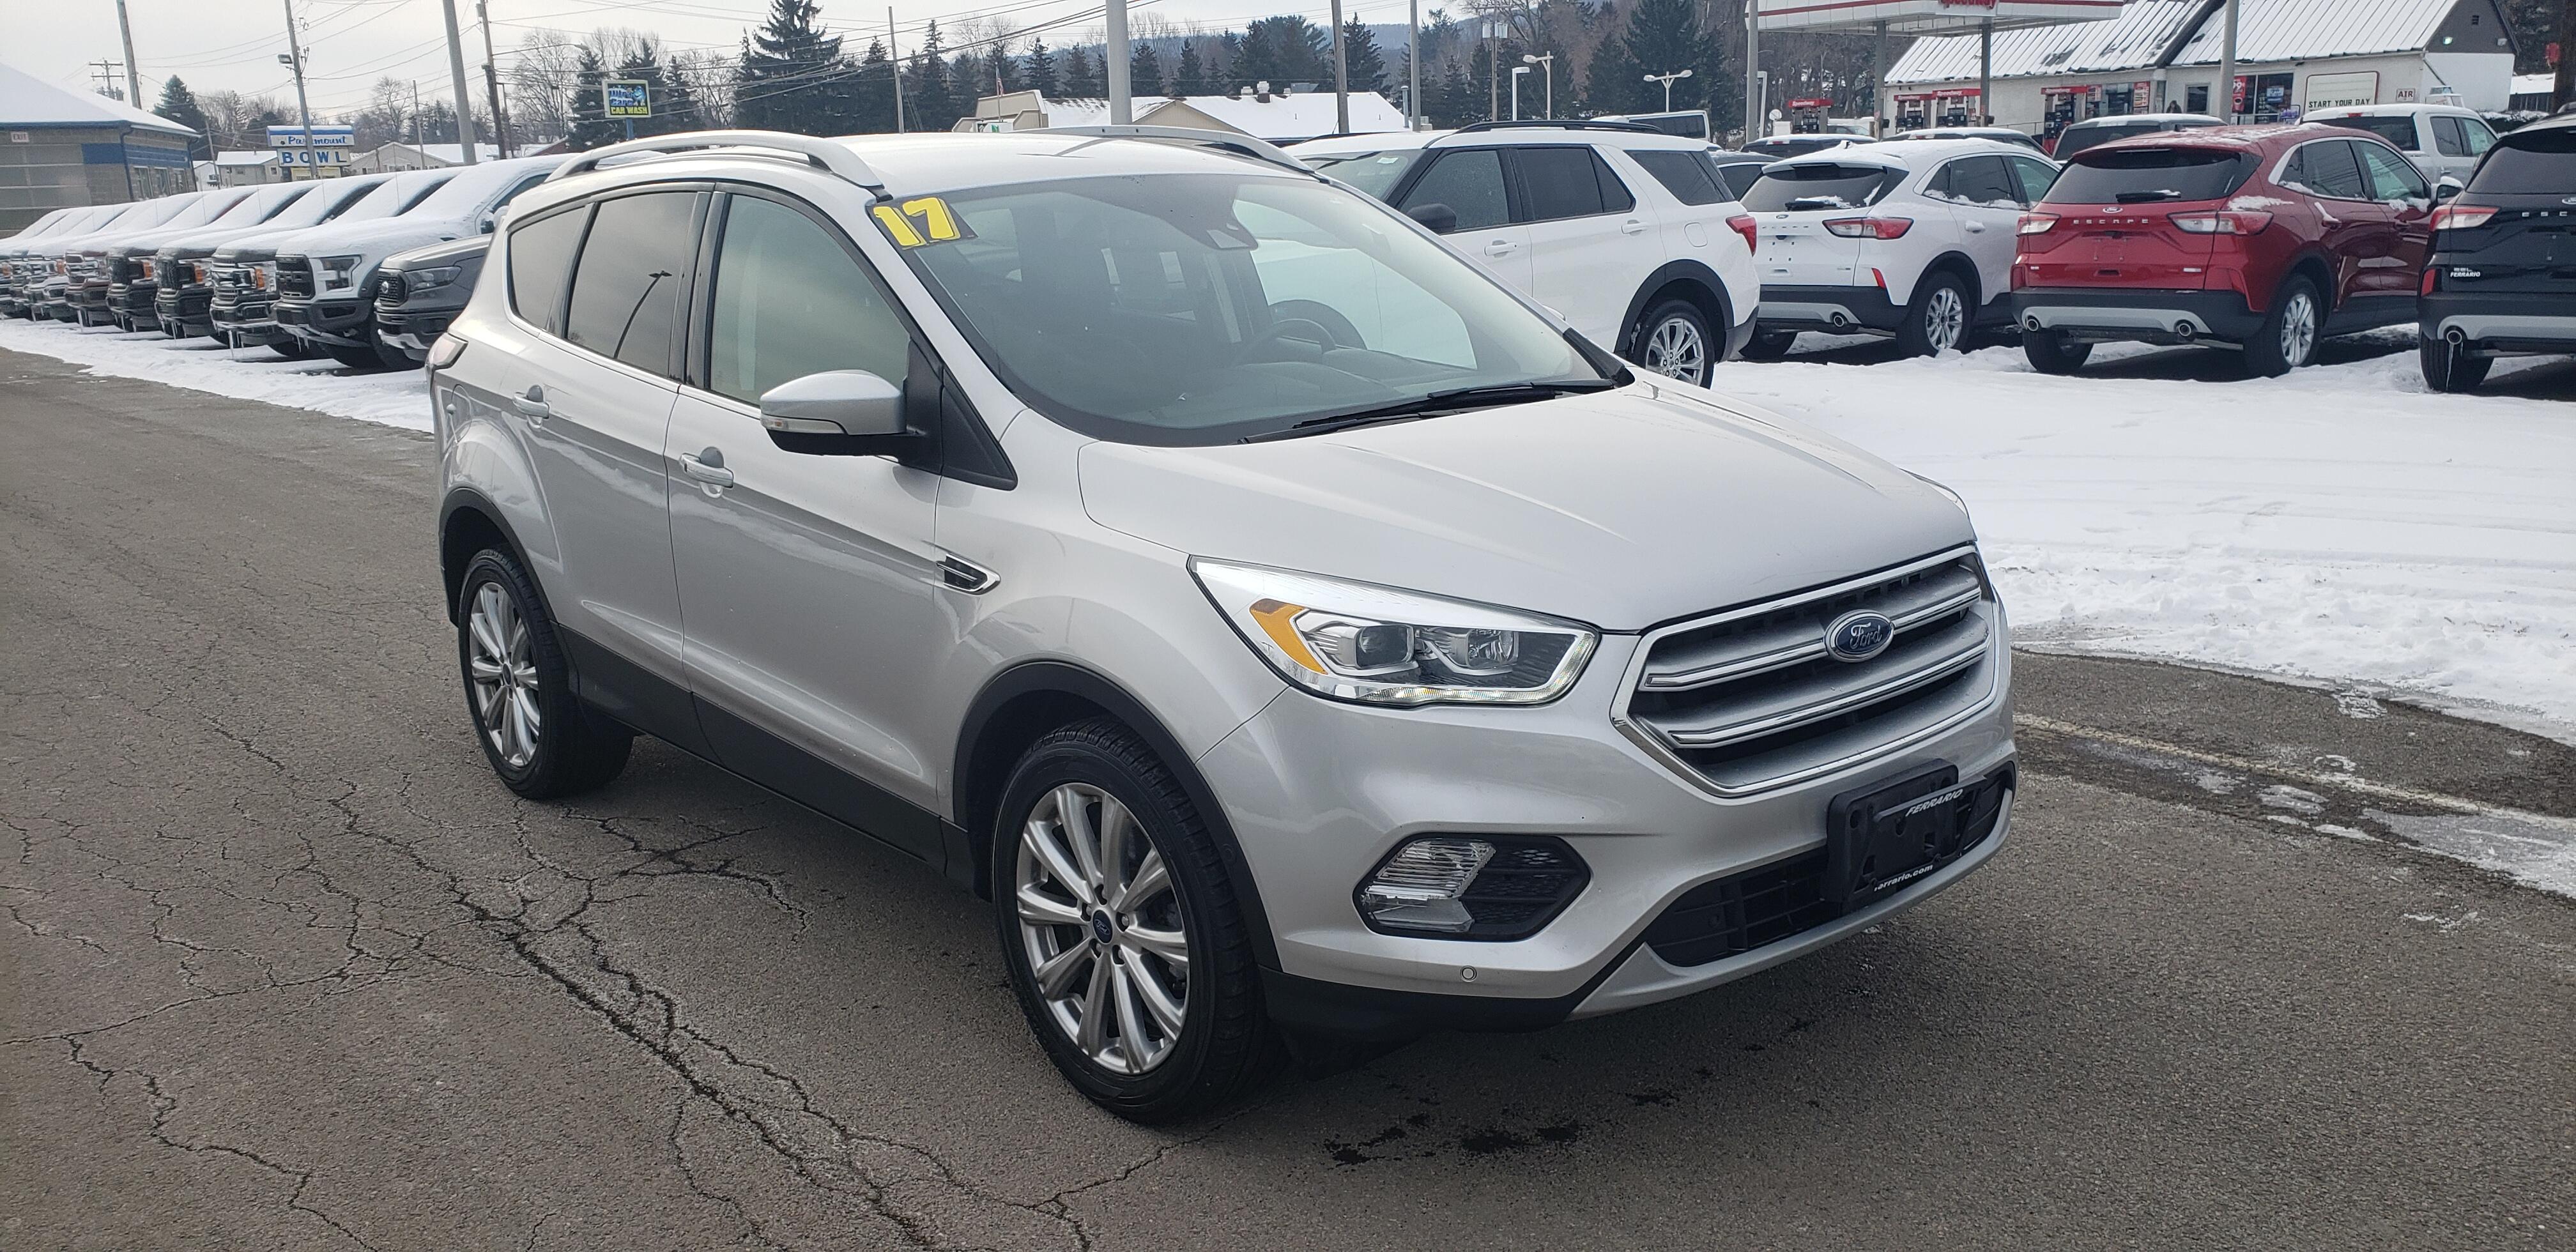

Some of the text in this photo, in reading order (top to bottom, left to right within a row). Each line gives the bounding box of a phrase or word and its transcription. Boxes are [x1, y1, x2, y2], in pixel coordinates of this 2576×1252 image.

[281, 151, 348, 164] BOWL
[873, 197, 961, 250] 17
[1850, 622, 1882, 649] Ford
[1905, 788, 1963, 818] FERRARIO
